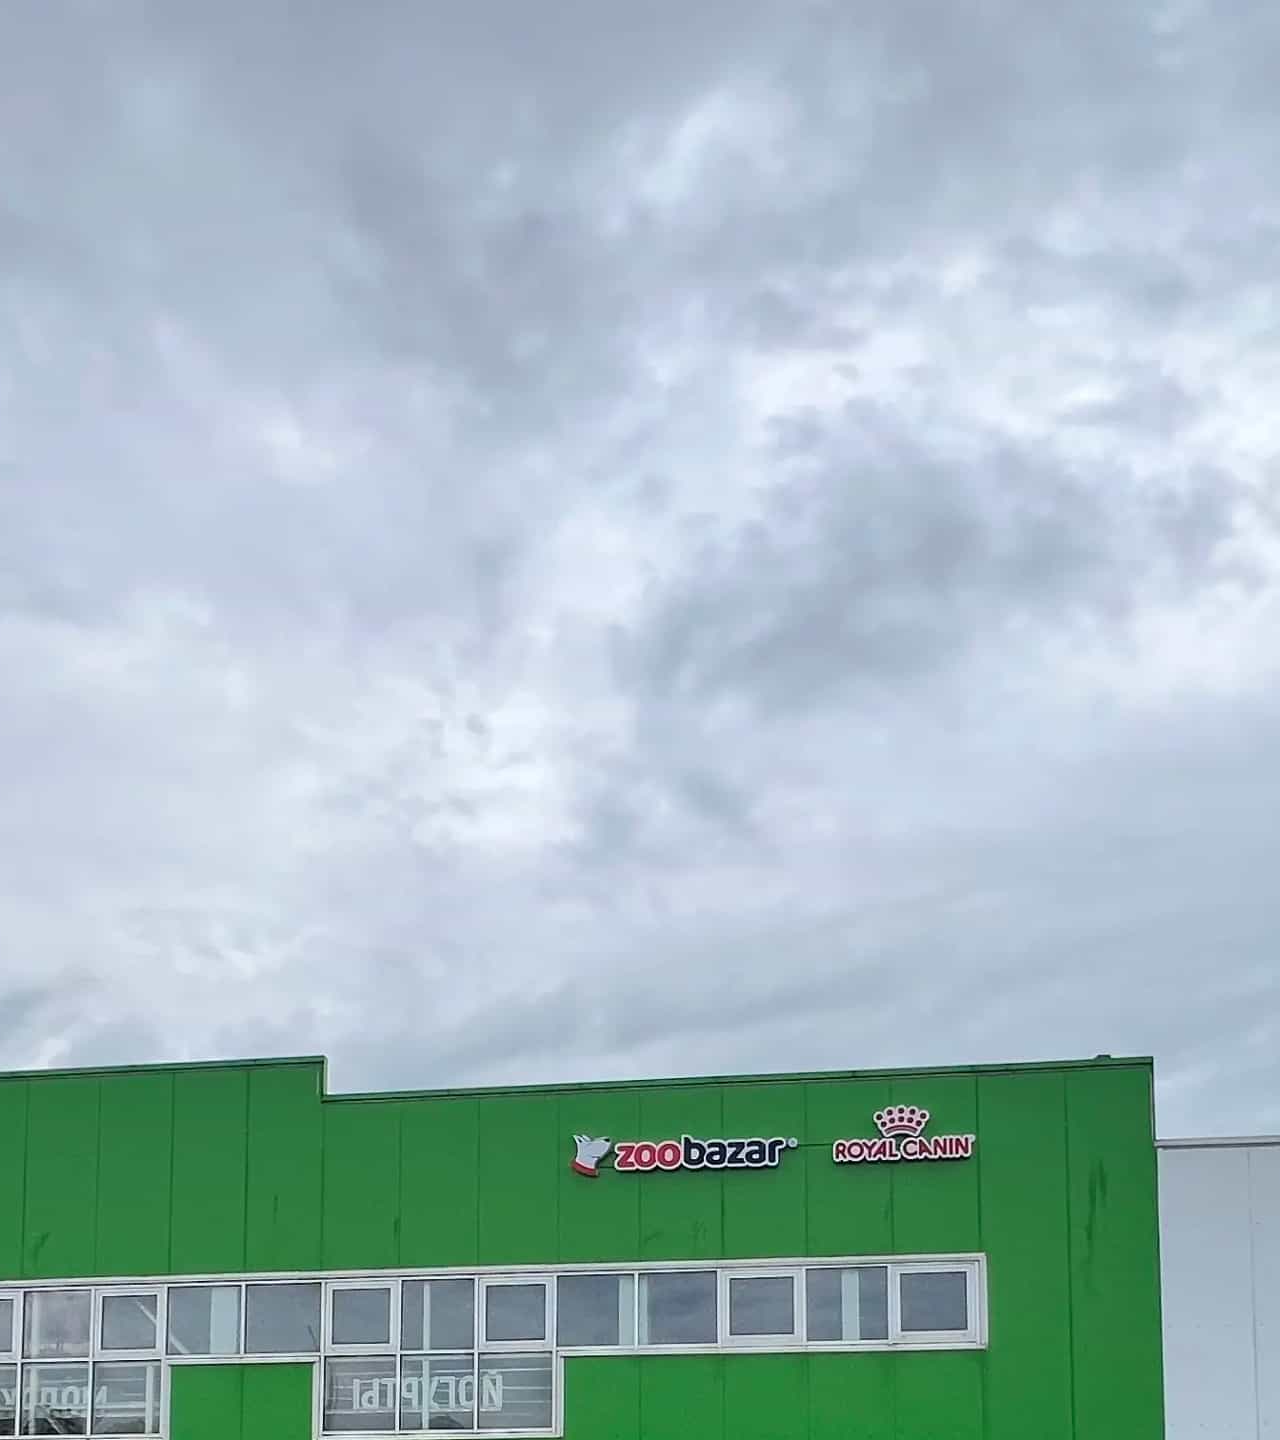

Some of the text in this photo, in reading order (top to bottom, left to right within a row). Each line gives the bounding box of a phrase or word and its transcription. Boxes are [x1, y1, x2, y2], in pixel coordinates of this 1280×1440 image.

[616, 1136, 785, 1168] zoobazar
[835, 1136, 970, 1159] ROYAL CANIN
